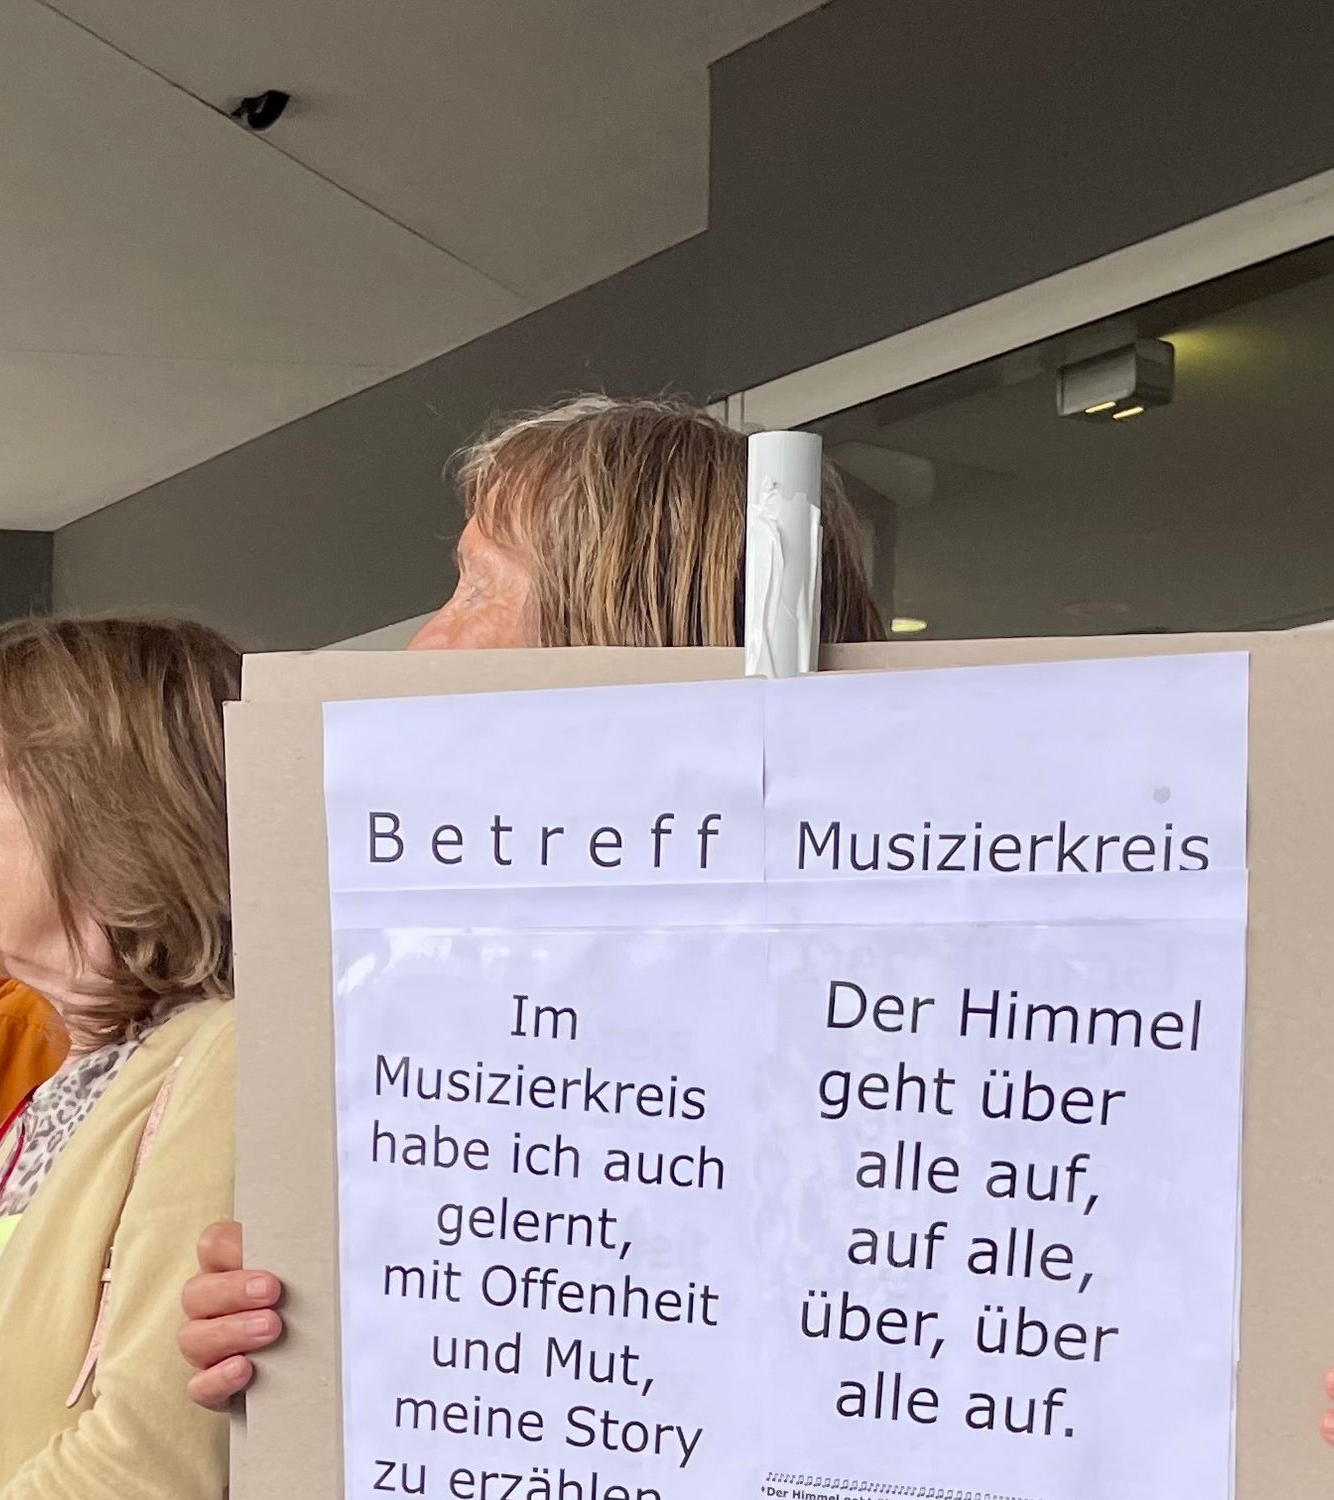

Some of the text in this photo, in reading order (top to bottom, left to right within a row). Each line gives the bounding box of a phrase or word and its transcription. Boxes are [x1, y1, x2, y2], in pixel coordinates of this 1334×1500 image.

[368, 810, 1210, 874] Betreff Musizierkreis
[509, 993, 578, 1041] Im
[825, 979, 1203, 1052] Der Himmel
[375, 1053, 707, 1121] Musizierkreis
[818, 1060, 1127, 1127] geht über
[371, 1118, 725, 1191] habe ich auch
[855, 1139, 1100, 1217] alle auf,
[436, 1195, 633, 1261] gelernt,
[846, 1220, 1094, 1295] auf alle,
[383, 1258, 720, 1327] mit Offenheit
[800, 1288, 1120, 1363] über, über
[432, 1330, 655, 1398] und Mut,
[394, 1394, 704, 1470] meine Story
[835, 1369, 1075, 1439] alle auf.
[372, 1458, 427, 1496] zu
